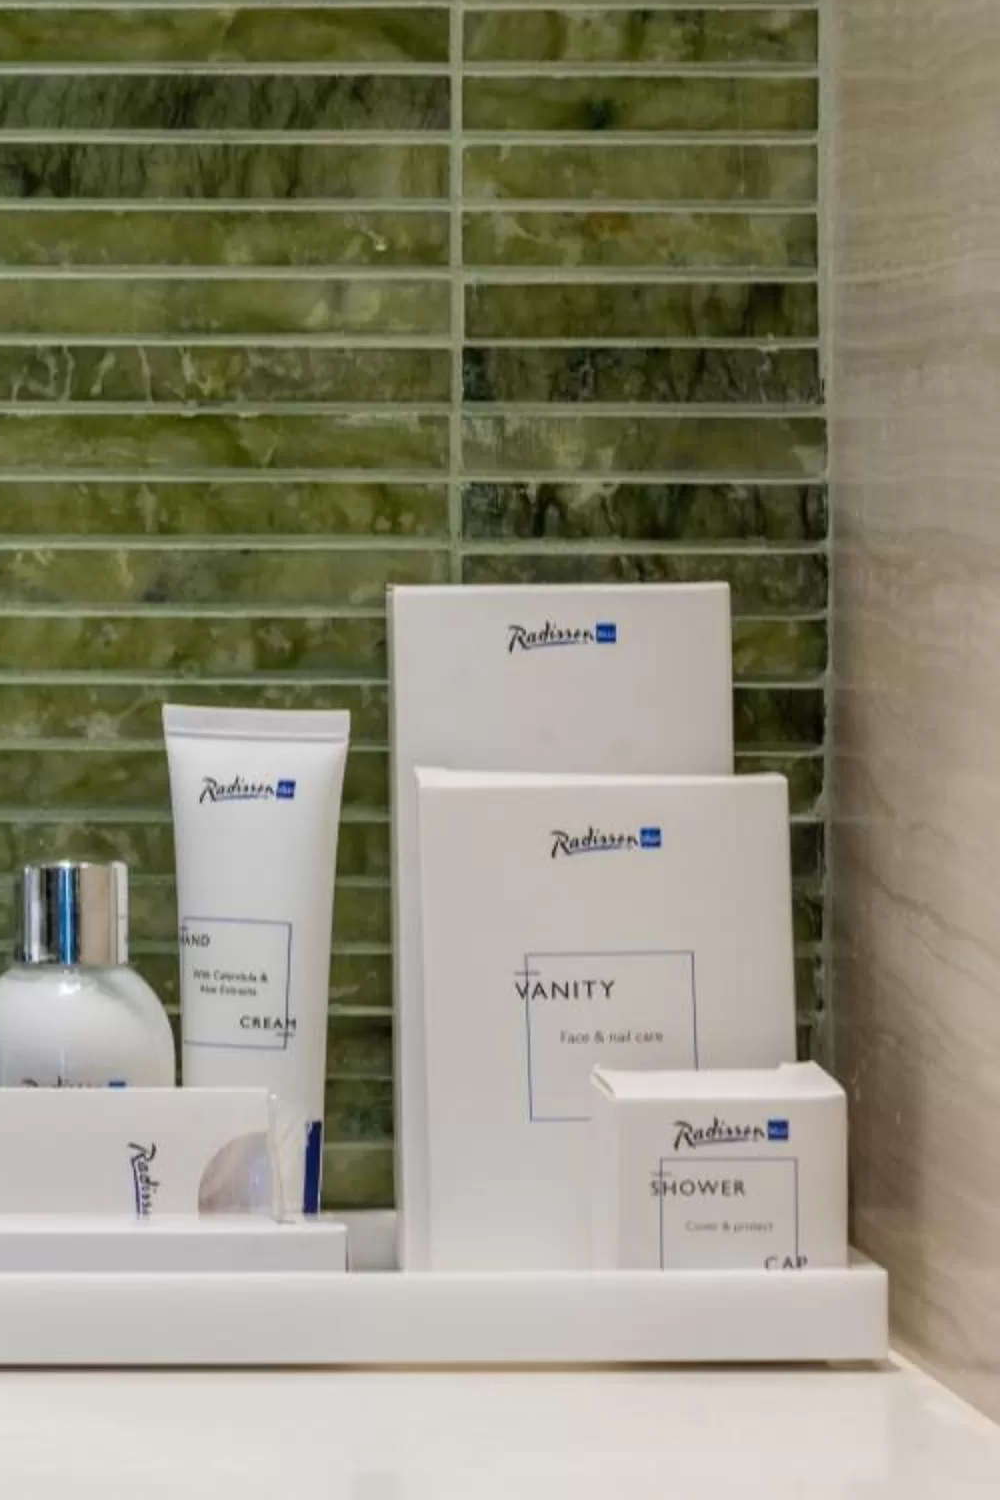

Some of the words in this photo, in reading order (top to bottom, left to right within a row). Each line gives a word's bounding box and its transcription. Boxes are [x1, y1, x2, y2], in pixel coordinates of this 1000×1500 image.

[508, 619, 595, 654] Radisson
[199, 773, 275, 804] Radisson
[550, 825, 639, 859] Radisson
[514, 979, 615, 1000] VANITY
[239, 1016, 297, 1030] CREAM
[673, 1116, 766, 1151] Radisson
[650, 1179, 745, 1197] SHOWER
